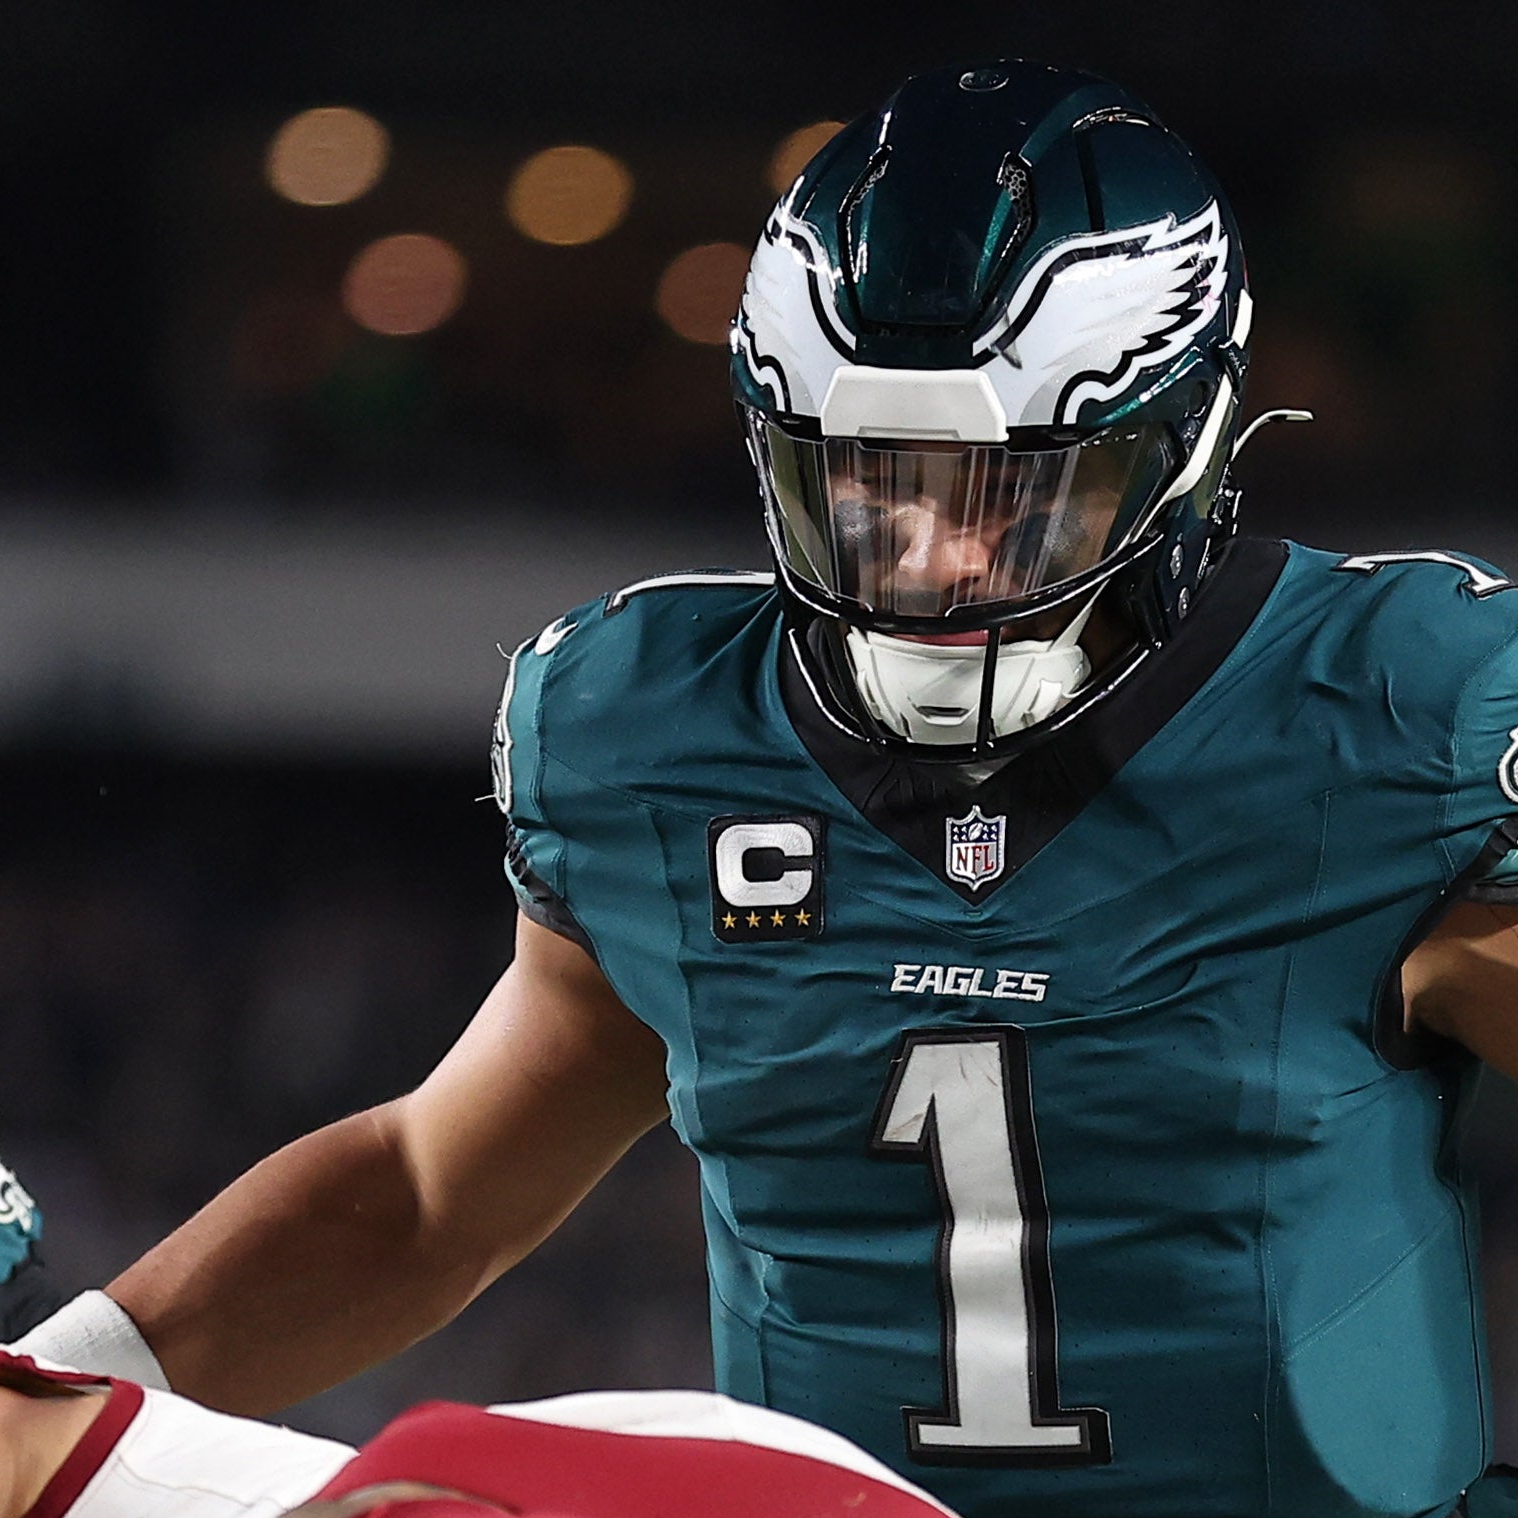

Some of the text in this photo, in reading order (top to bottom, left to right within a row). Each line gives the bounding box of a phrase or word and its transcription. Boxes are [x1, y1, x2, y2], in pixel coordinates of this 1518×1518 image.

[715, 823, 814, 907] C
[955, 844, 995, 876] NFL
[891, 963, 1051, 1002] EAGLES
[879, 1039, 1086, 1452] 1
